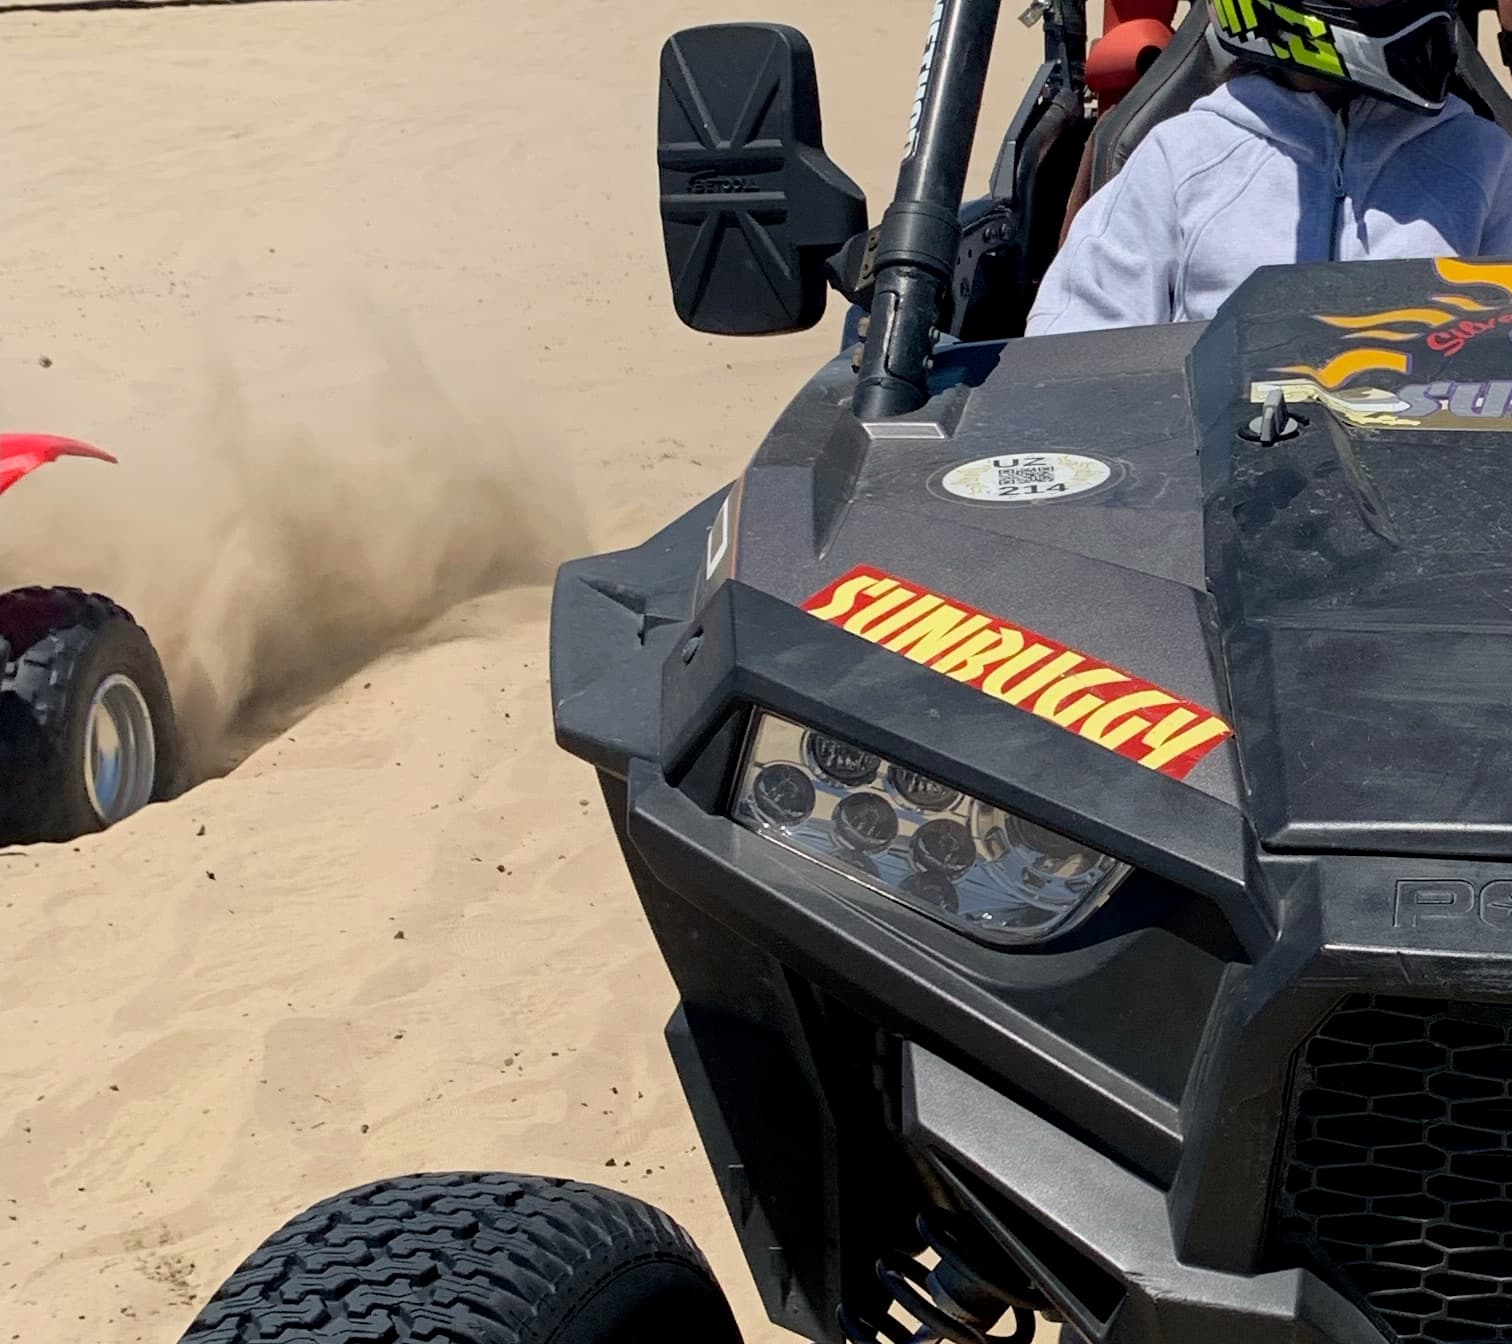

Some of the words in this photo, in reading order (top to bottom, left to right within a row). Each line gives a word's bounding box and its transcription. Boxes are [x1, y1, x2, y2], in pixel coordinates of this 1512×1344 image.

[993, 457, 1046, 468] UZ
[998, 483, 1068, 497] 214
[807, 575, 1233, 771] SUNBUGGY
